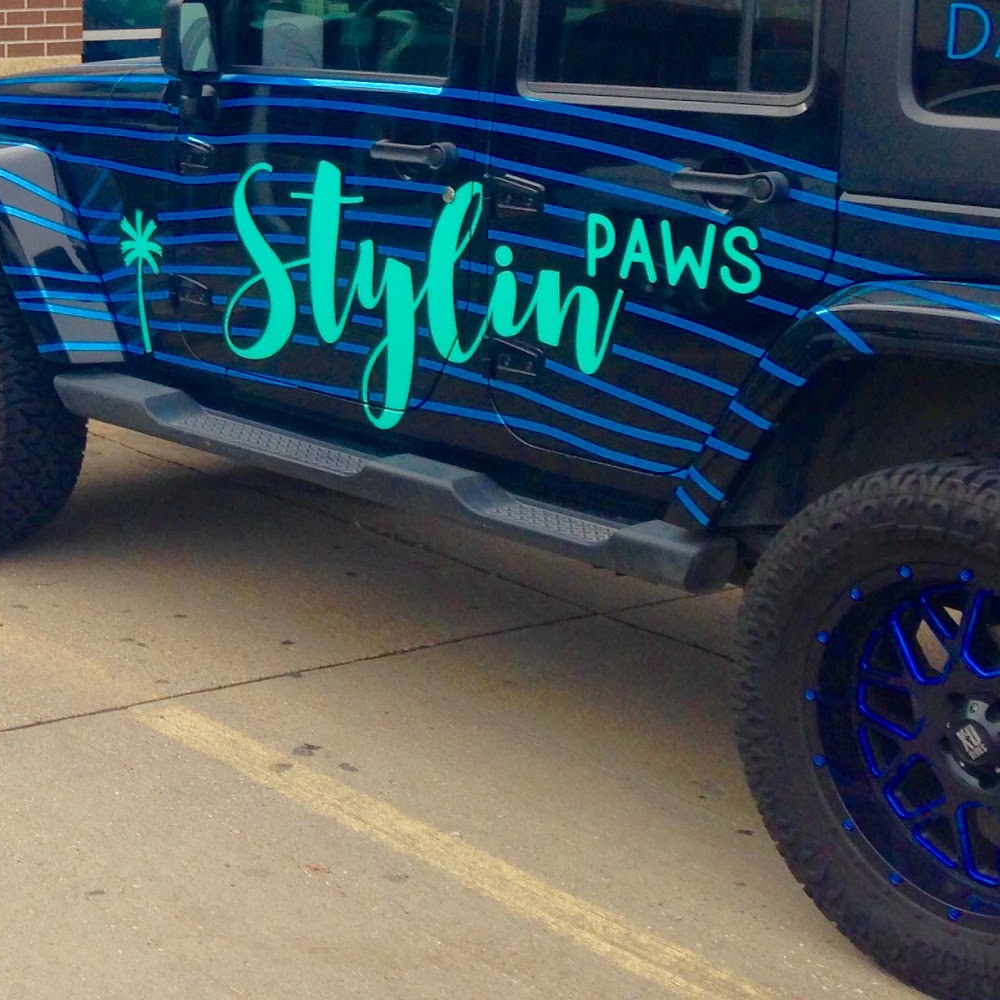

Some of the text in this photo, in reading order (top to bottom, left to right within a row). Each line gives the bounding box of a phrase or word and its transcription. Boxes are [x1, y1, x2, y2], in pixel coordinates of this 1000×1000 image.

[948, 2, 1000, 60] D
[224, 160, 761, 430] Stylin PAWS
